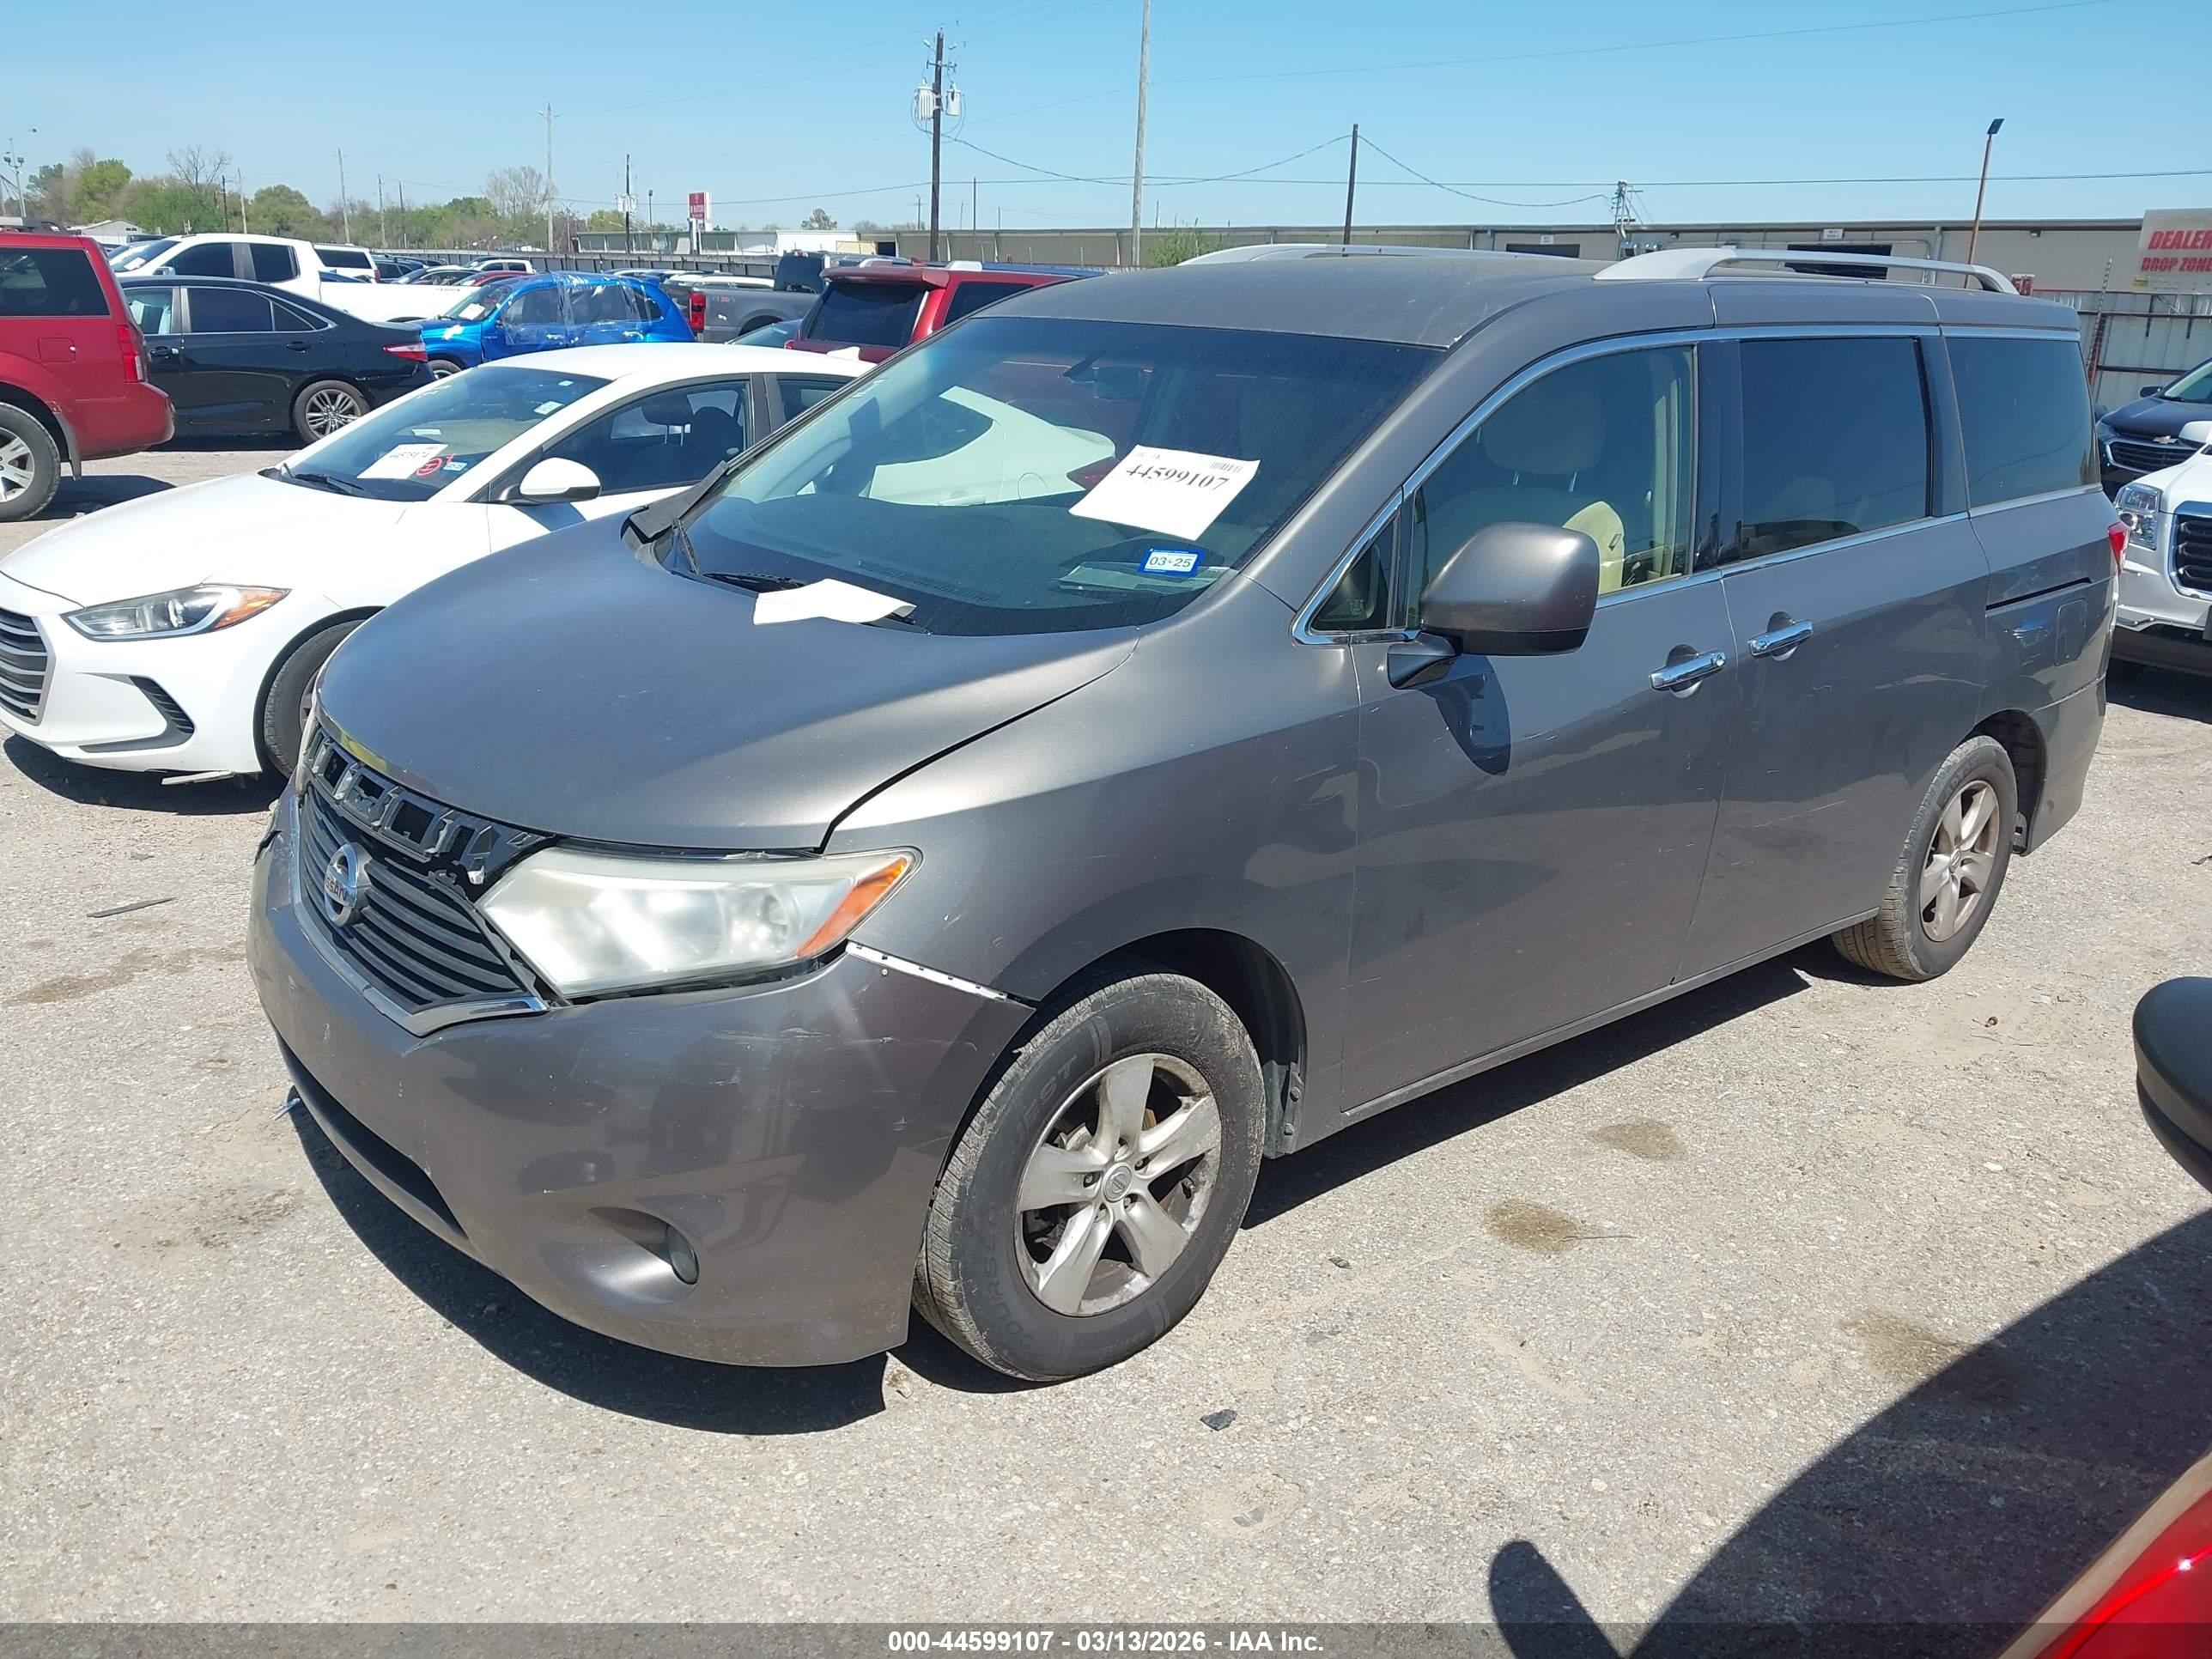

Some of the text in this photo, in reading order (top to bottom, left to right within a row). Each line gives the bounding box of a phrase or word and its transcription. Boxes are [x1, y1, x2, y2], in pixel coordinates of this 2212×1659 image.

[2141, 257, 2212, 272] DROP ZONE
[1126, 464, 1231, 490] 44599107
